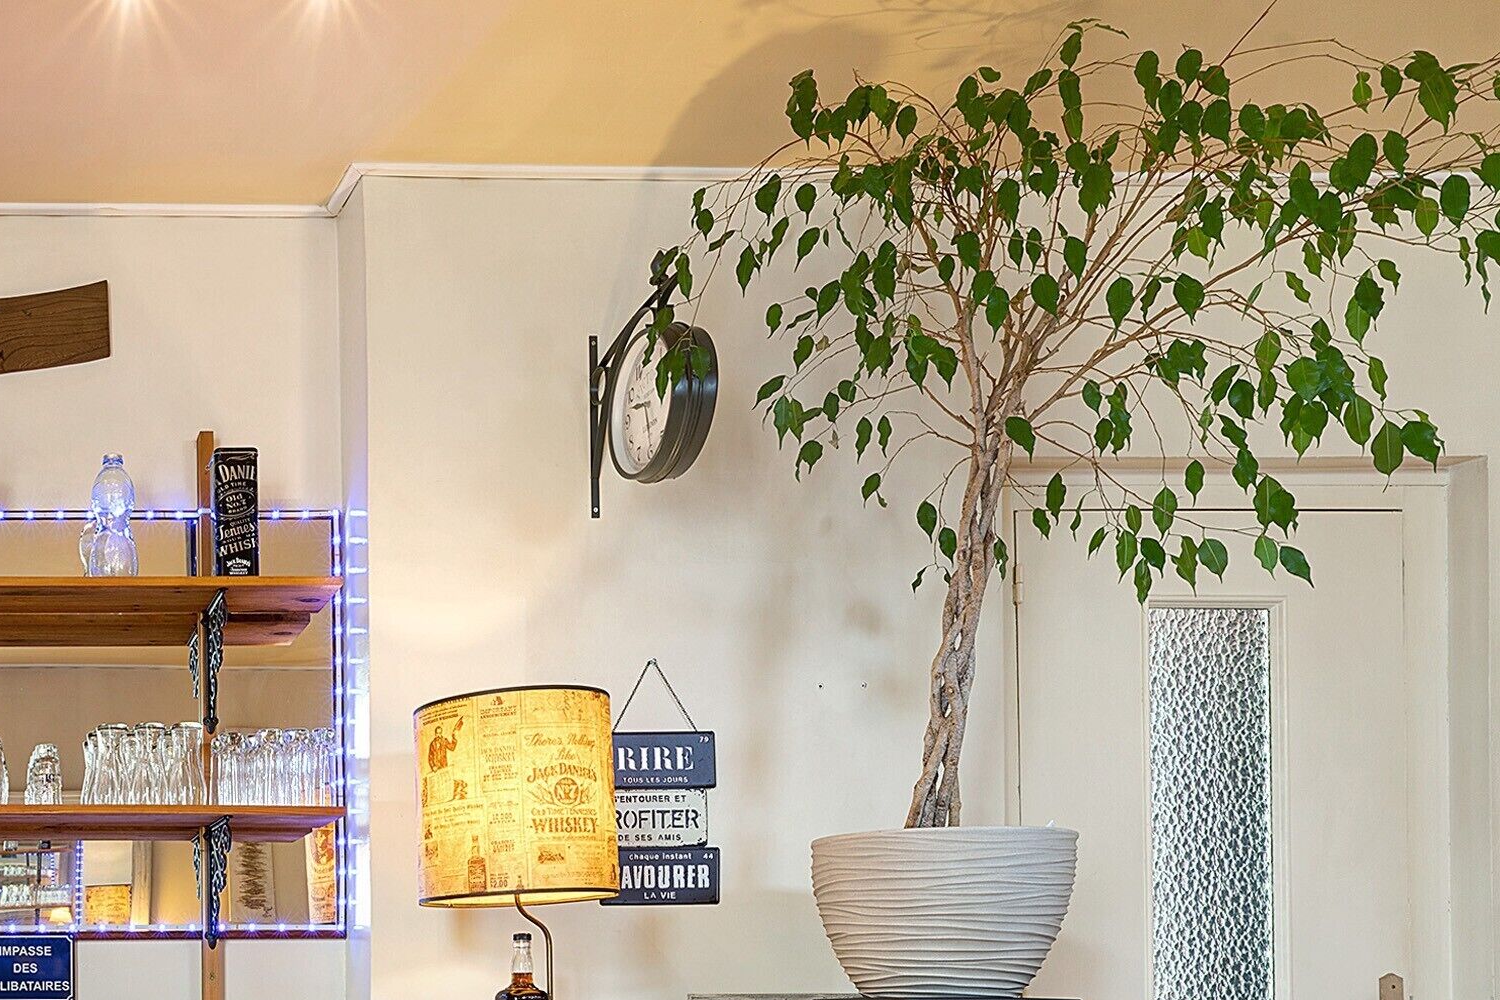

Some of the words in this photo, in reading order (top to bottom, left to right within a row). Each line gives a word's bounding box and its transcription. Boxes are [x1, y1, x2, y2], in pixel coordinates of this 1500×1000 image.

[226, 493, 243, 502] Old
[617, 746, 695, 771] RIRE
[527, 765, 558, 783] JACK
[532, 817, 598, 833] WHISKEY
[629, 853, 659, 861] chaque
[662, 852, 692, 860] instant
[13, 963, 38, 973] DES
